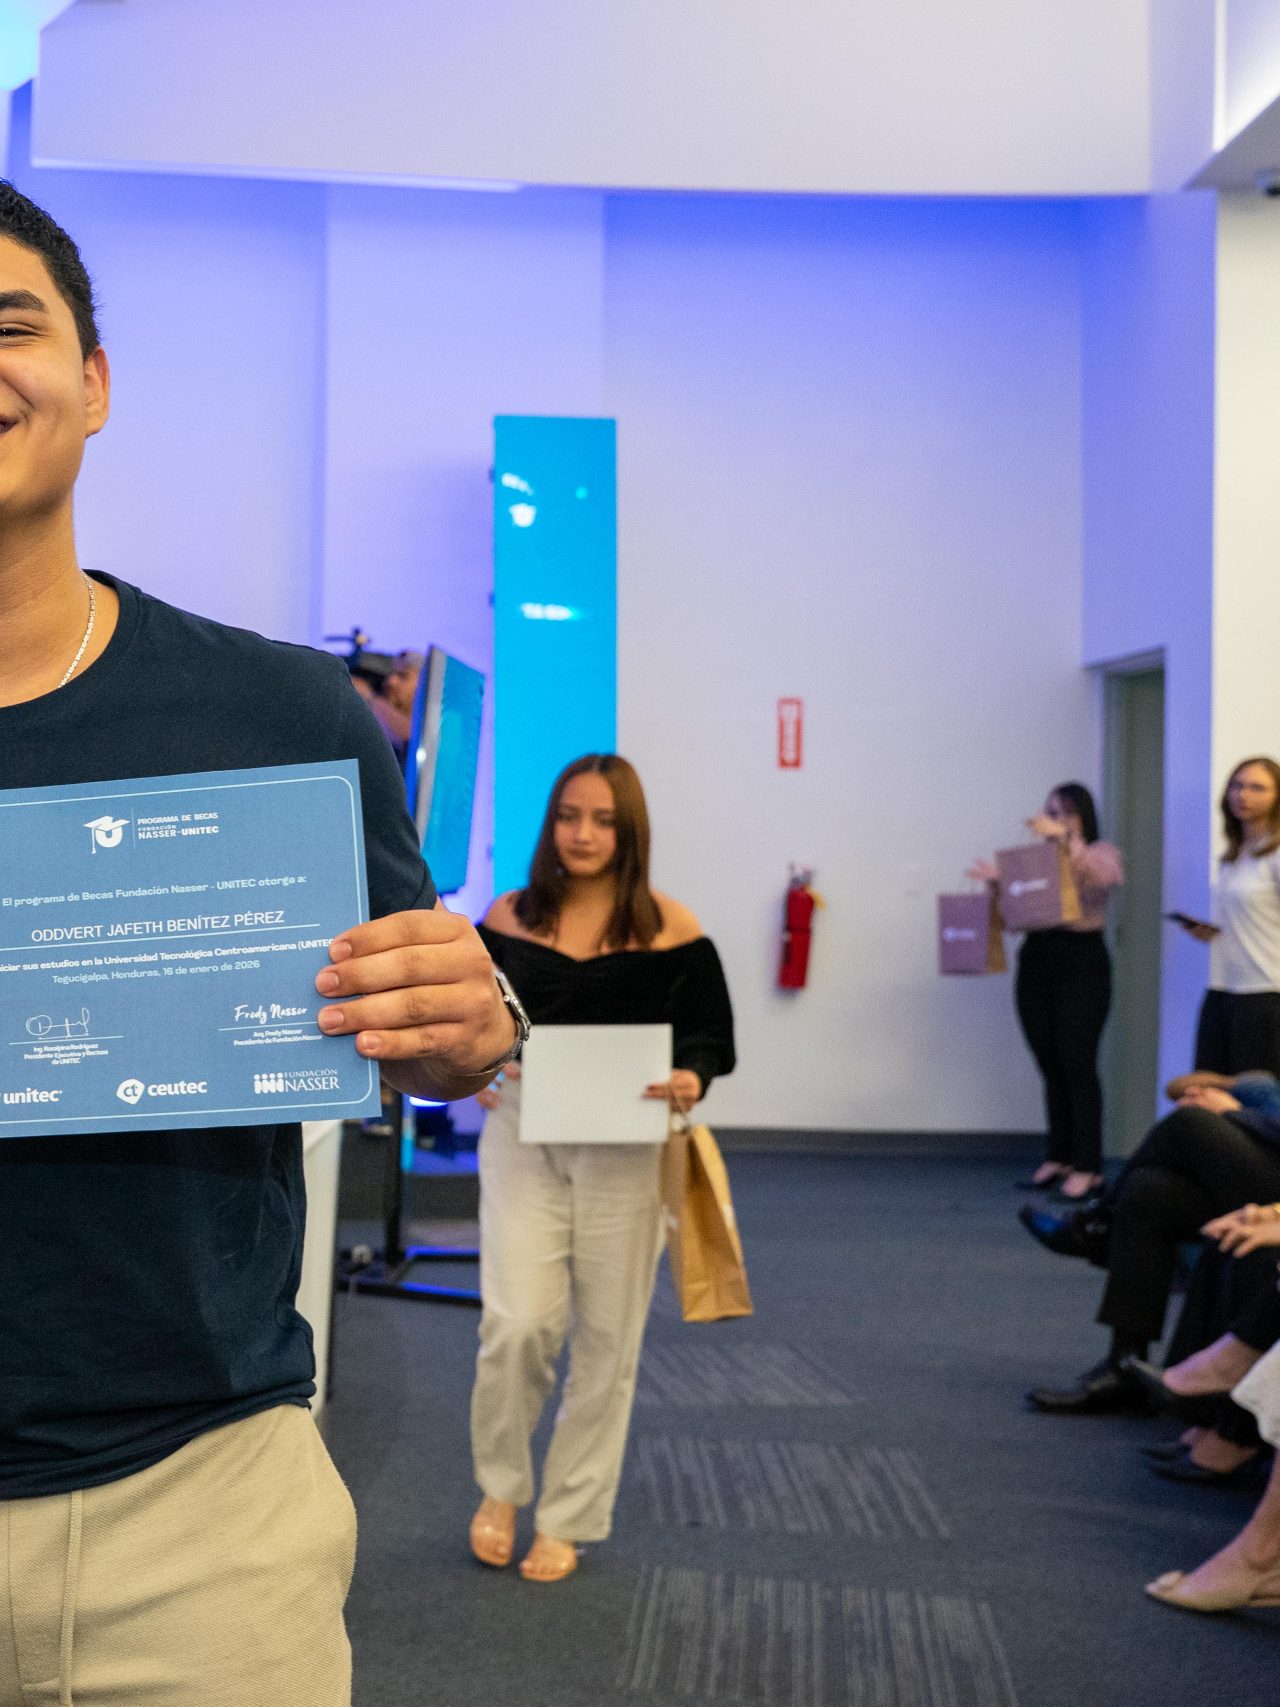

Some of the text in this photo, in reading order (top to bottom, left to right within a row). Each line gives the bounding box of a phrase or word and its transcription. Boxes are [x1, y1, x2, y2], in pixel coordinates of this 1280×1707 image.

[137, 815, 179, 825] PROGRAMA
[194, 812, 219, 821] BECAS
[2, 898, 12, 906] El
[14, 895, 65, 907] programa
[67, 892, 80, 902] de
[82, 890, 114, 901] Becas
[115, 885, 169, 898] Fundación
[171, 884, 208, 895] Nasser
[216, 878, 256, 890] UNITEC
[258, 876, 295, 887] otorga
[297, 876, 307, 884] a:
[31, 910, 285, 942] ODDVERT JAFETH BENÍTEZ PÉREZ
[22, 963, 39, 971] sus
[40, 959, 80, 969] estudios
[81, 958, 93, 967] en
[94, 957, 103, 966] la
[103, 953, 158, 965] Universidad
[160, 948, 213, 961] Tecnológica
[214, 942, 297, 957] Centroamericana
[163, 966, 173, 975] 16
[175, 965, 188, 975] de
[189, 964, 218, 974] enero
[220, 962, 233, 972] de
[234, 960, 260, 970] 2026
[284, 1068, 338, 1079] FUNDACIÓN
[147, 1080, 208, 1097] ceutec
[284, 1076, 340, 1092] NASSER
